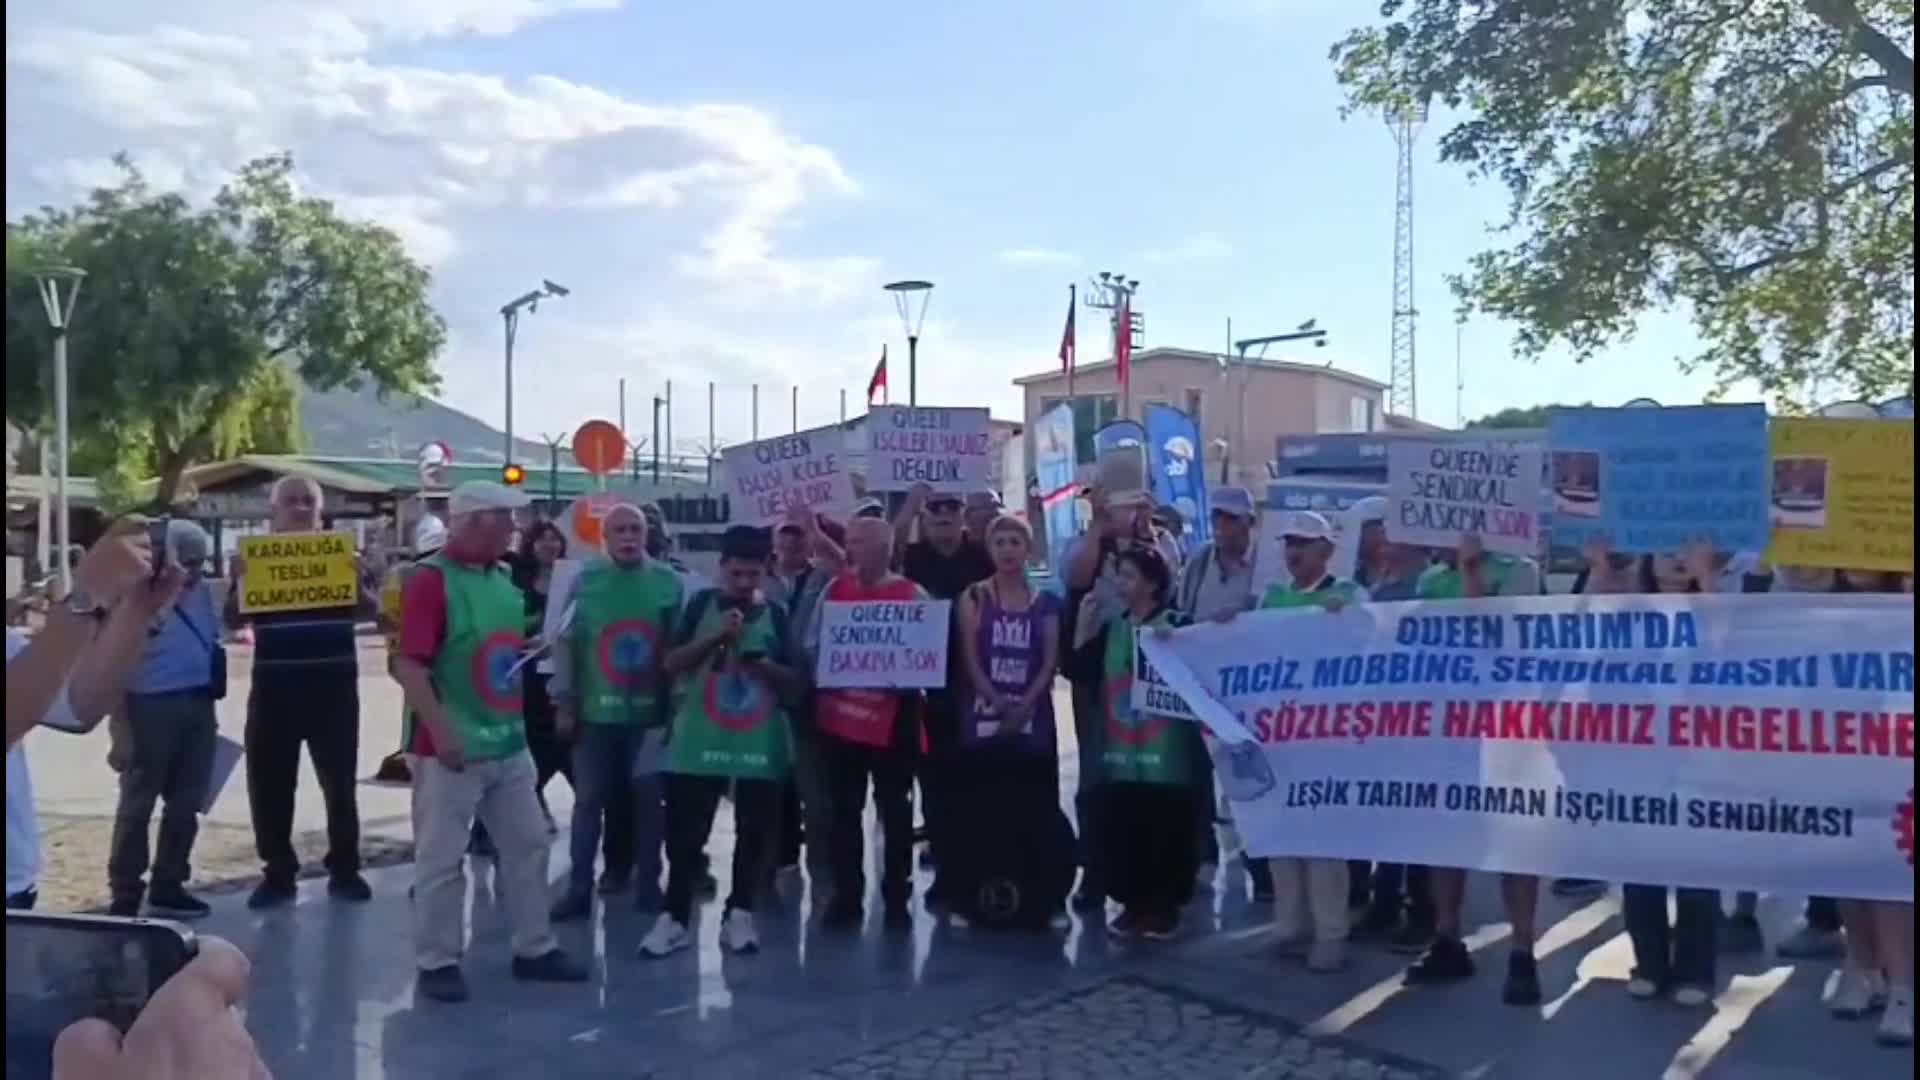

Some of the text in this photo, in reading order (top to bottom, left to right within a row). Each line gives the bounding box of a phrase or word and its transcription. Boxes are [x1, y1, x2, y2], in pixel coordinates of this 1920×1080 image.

[754, 437, 811, 464] QUEEN
[247, 536, 346, 559] KARANLIĞA
[246, 584, 354, 608] OLMUYORUZ
[1514, 610, 1698, 649] TARIM'DA
[1689, 655, 1818, 688] BASKI
[1829, 651, 1914, 692] VAR
[1253, 697, 1914, 758] SÖZLEŞME HAKKIMIZ ENGELLENE
[1355, 780, 1438, 809] TARIM
[1446, 783, 1547, 818] ORMAN
[1554, 785, 1679, 827] İŞÇİLERİ
[1686, 797, 1854, 838] SENDİKASI
